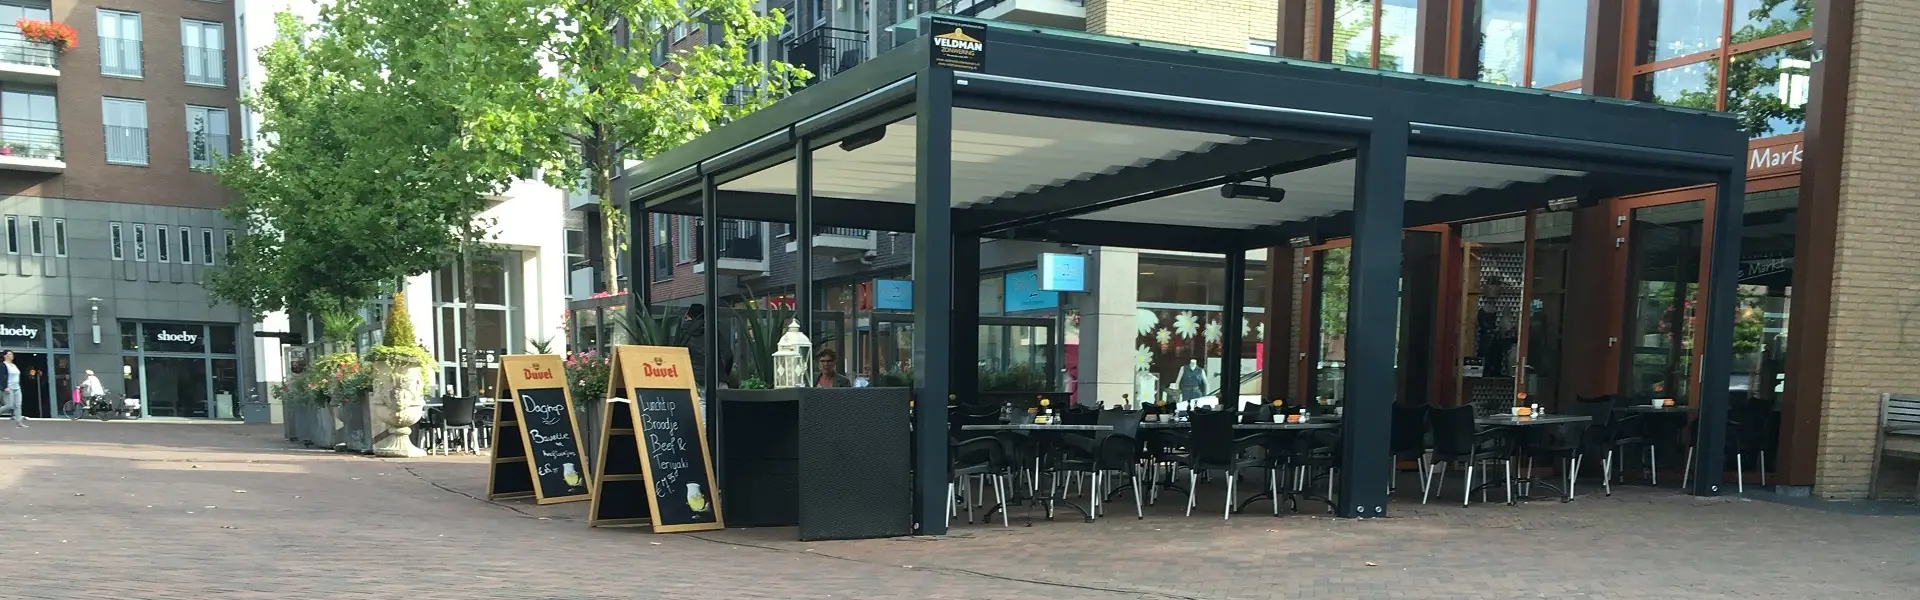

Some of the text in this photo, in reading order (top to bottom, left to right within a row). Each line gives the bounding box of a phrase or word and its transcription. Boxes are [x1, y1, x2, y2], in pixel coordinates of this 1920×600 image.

[934, 37, 983, 52] VELDMAN
[0, 323, 38, 339] hoeby
[157, 329, 198, 345] shoeby
[523, 368, 554, 380] Duvel
[643, 362, 679, 378] Duvel
[641, 413, 679, 436] Broodje
[650, 433, 687, 454] Beef &
[652, 453, 689, 470] Teriyaki
